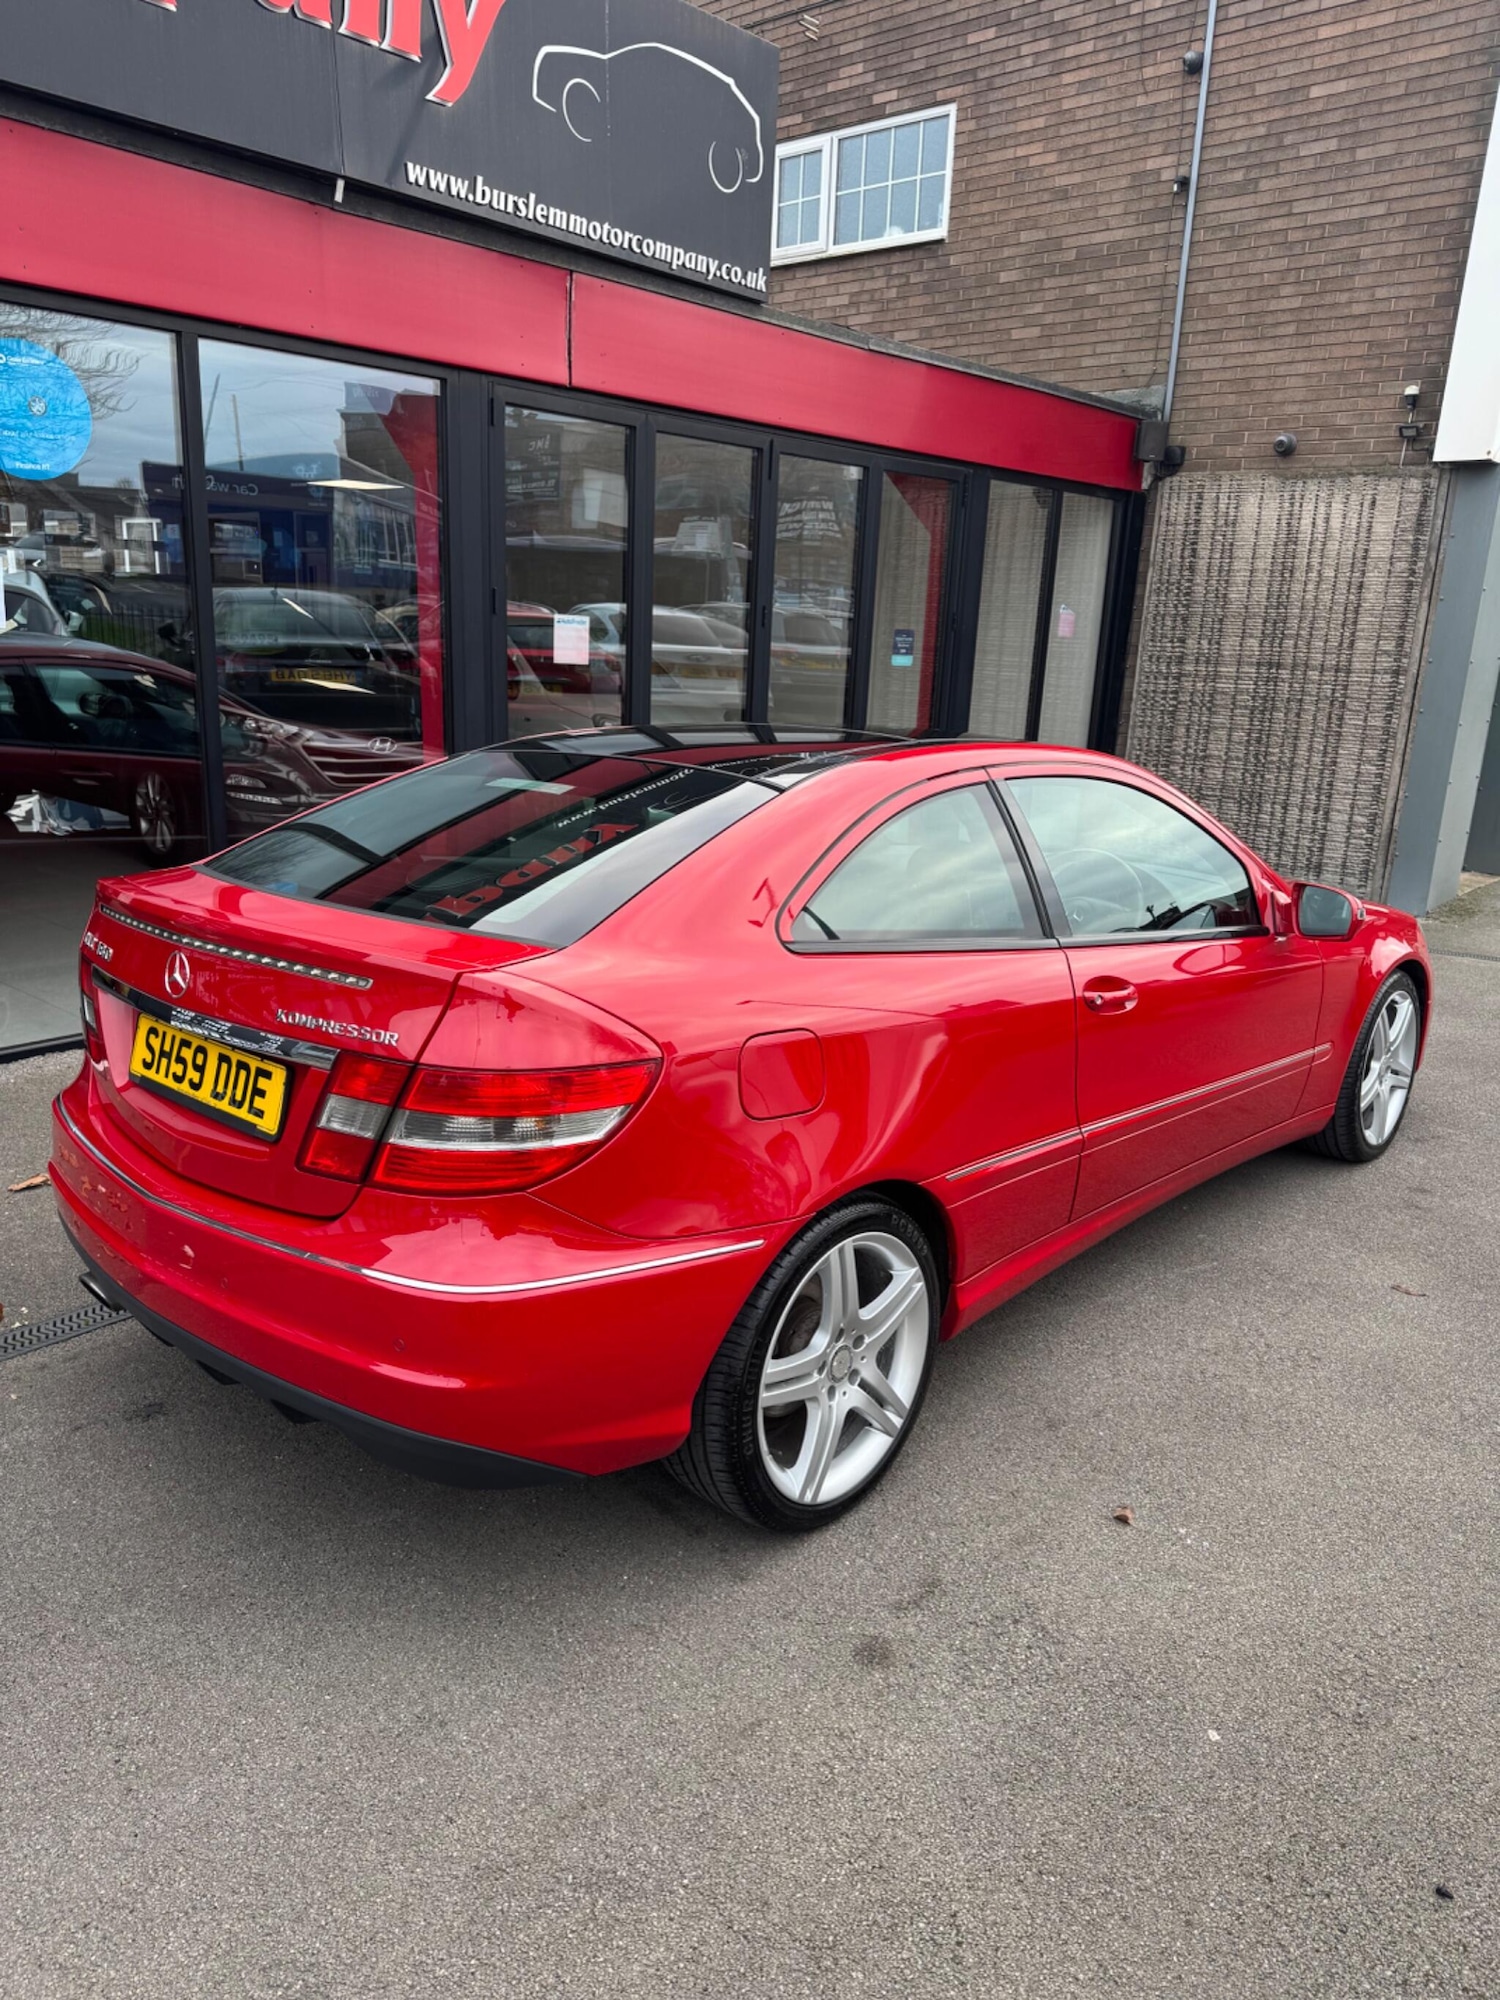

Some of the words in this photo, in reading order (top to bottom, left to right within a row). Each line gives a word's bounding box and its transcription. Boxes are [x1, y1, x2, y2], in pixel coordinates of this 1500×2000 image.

[405, 161, 768, 293] www.burslemmotorcompany.co.uk
[141, 1026, 208, 1091] SH59
[210, 1052, 273, 1120] DDE
[276, 1008, 400, 1047] KOMPRESSOR
